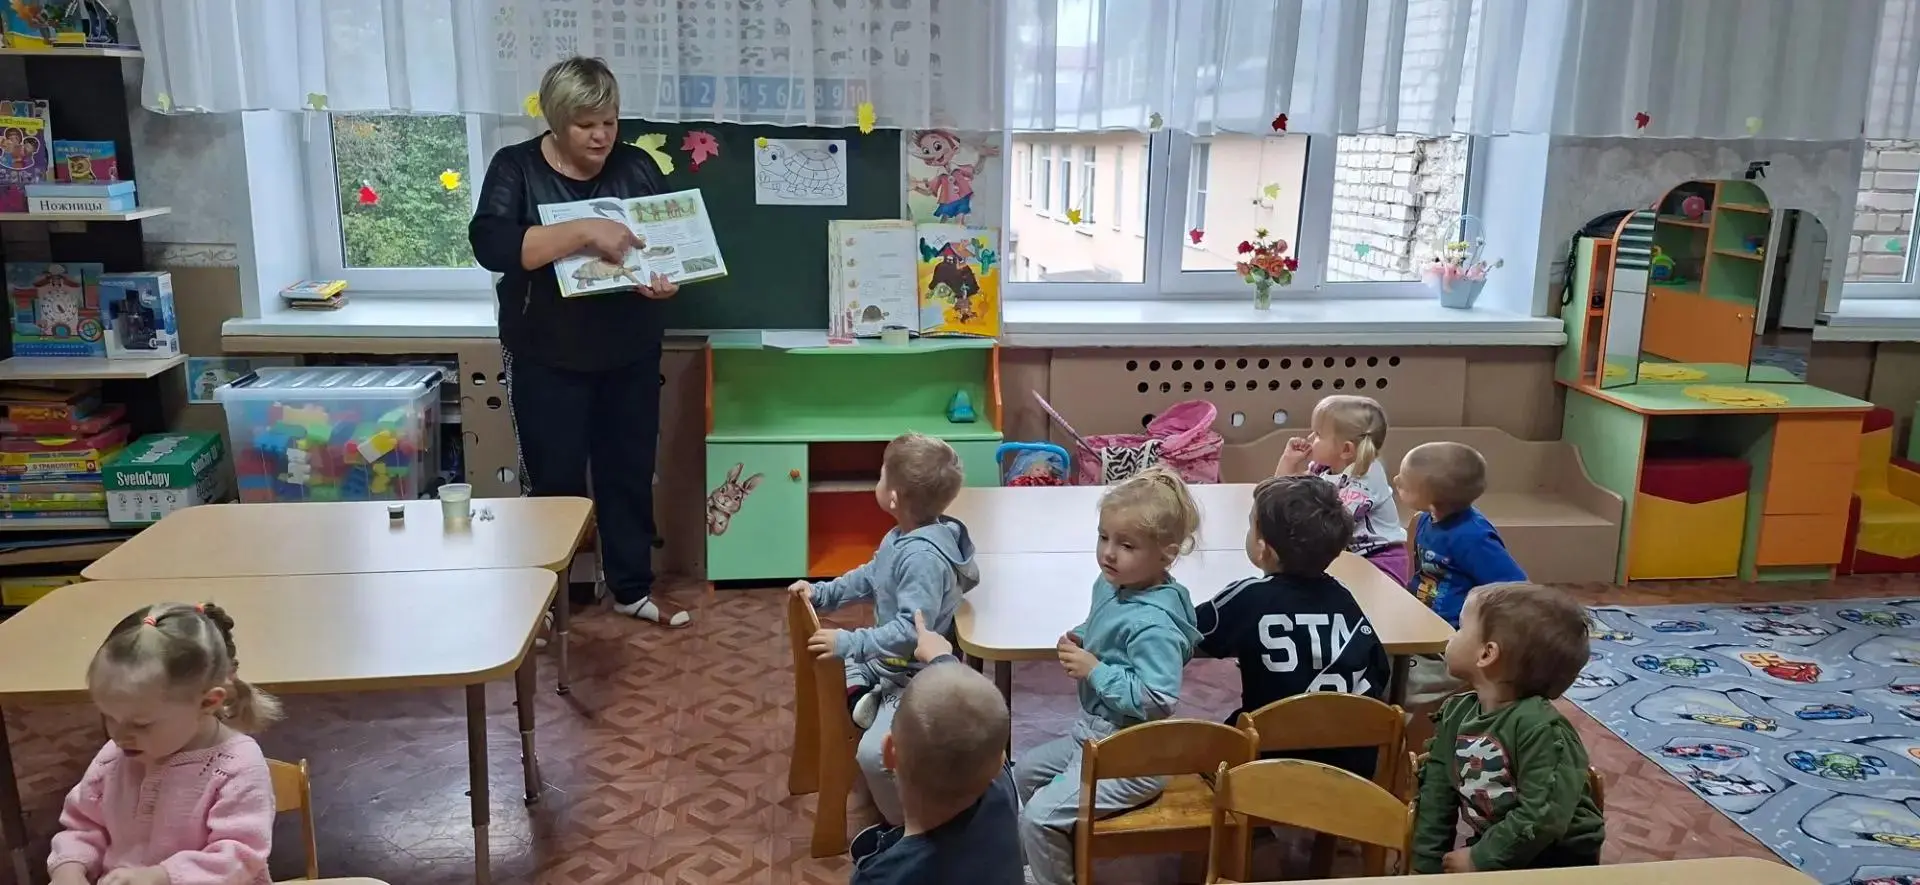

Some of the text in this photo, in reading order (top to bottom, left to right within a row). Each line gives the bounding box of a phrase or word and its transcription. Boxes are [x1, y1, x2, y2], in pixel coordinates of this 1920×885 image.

[661, 81, 672, 103] 0
[700, 82, 710, 103] 2
[758, 84, 767, 105] 5
[776, 84, 786, 106] 6
[814, 85, 824, 106] 8
[832, 85, 842, 106] 9
[848, 85, 865, 107] 10
[39, 200, 102, 211] Ножницы
[116, 470, 170, 487] SvetoCopy
